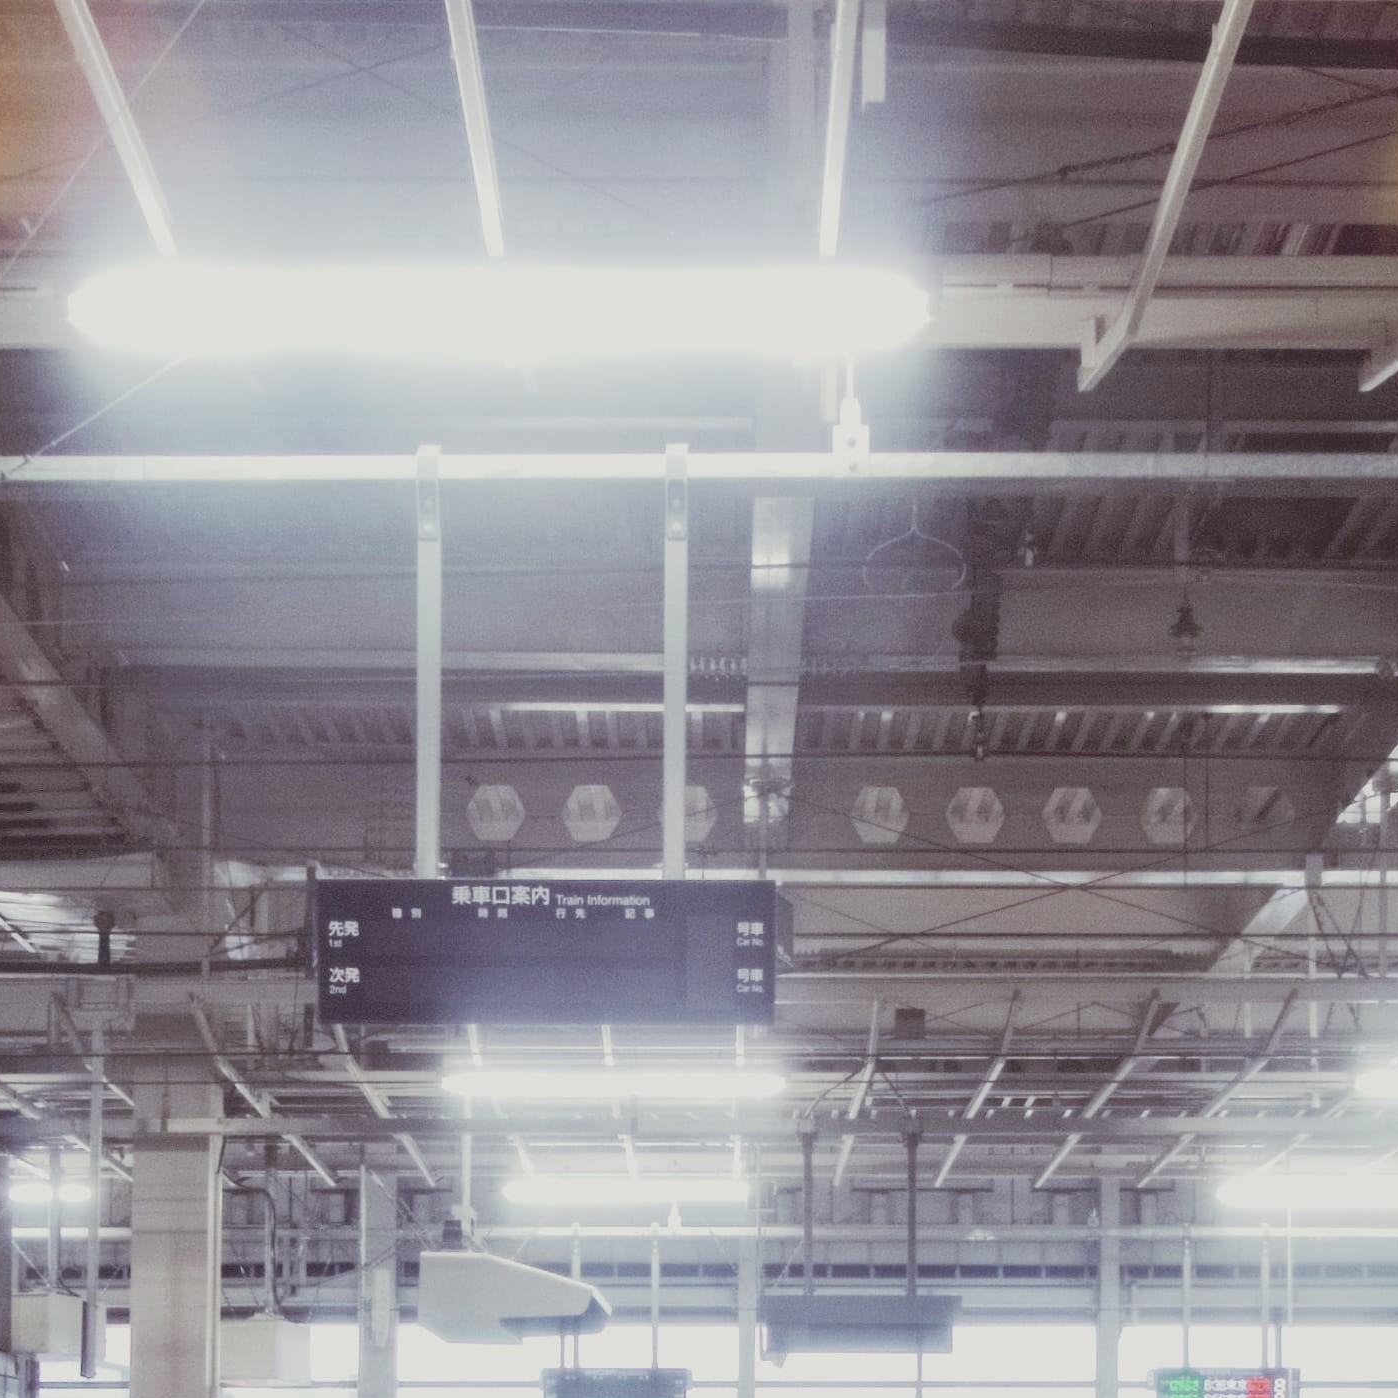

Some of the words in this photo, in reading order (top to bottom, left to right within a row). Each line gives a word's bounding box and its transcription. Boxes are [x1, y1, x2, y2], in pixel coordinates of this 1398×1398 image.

[452, 885, 550, 906] 乗車口案内
[556, 894, 584, 906] Train
[587, 894, 650, 906] Information
[328, 920, 360, 937] 先発
[329, 967, 361, 984] 次発
